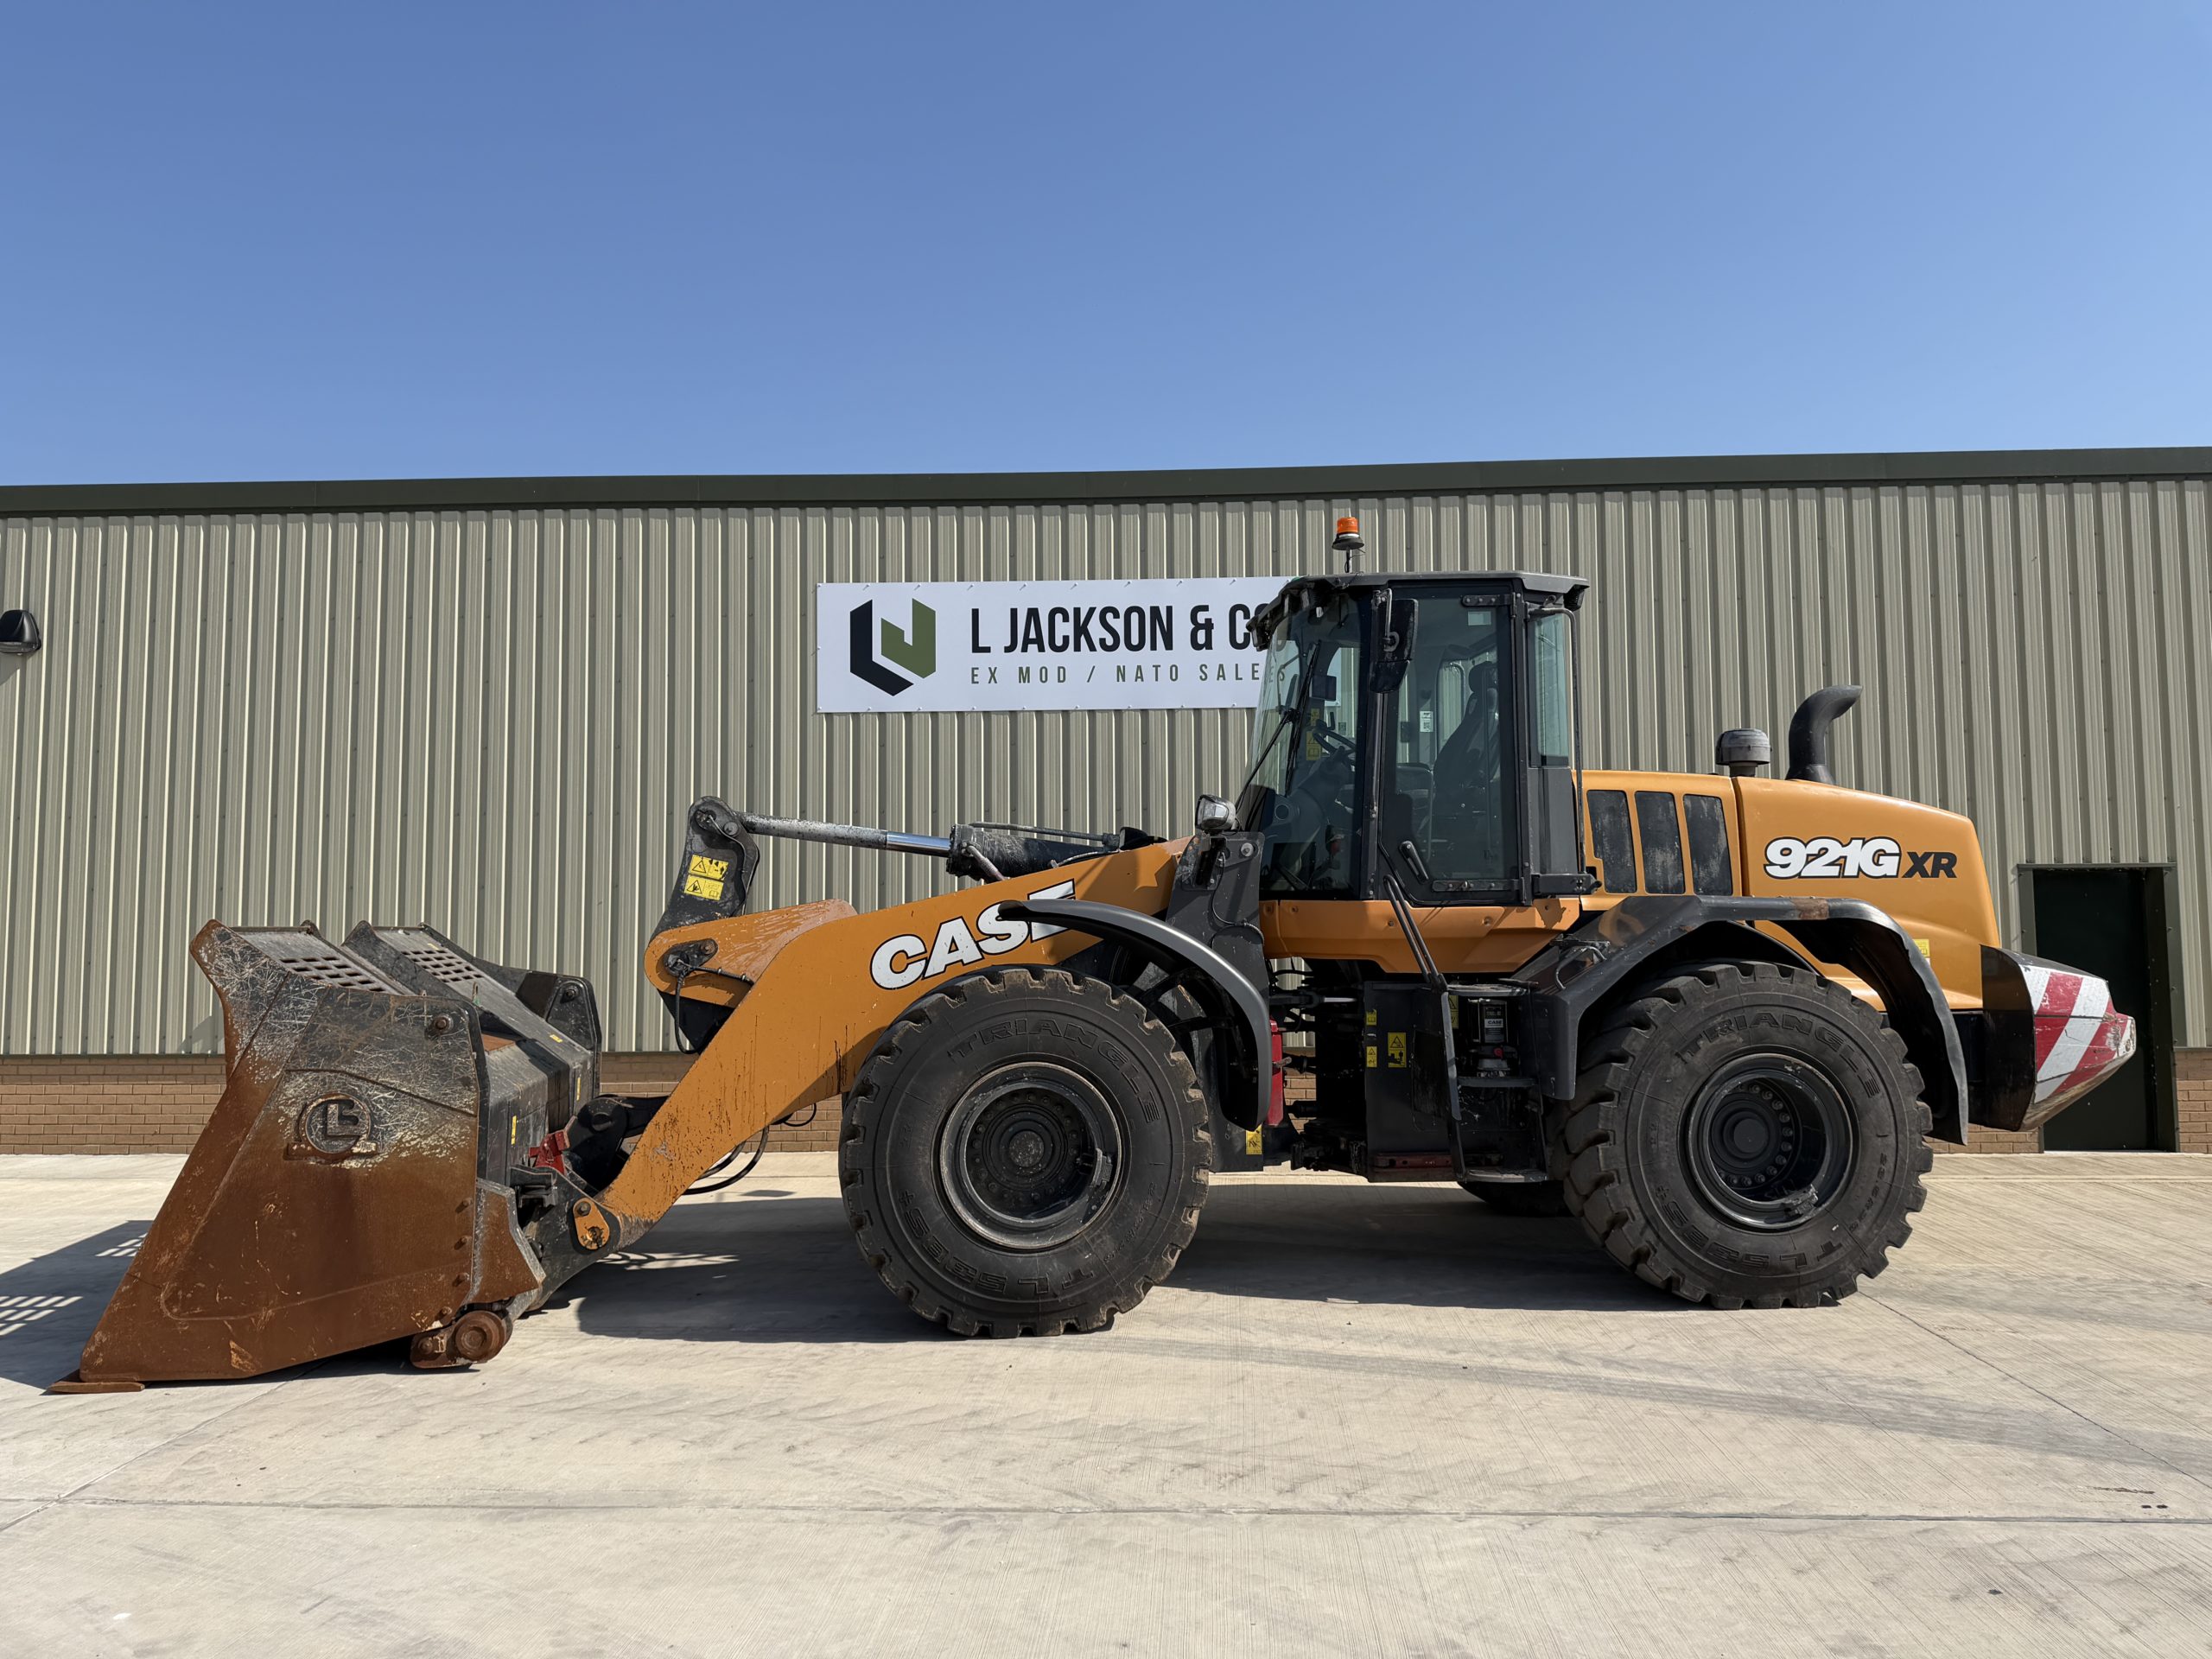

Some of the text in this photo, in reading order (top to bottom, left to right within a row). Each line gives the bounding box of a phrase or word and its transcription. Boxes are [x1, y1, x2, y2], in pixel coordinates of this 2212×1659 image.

[971, 608, 991, 653] L
[1004, 605, 1173, 653] JACKSON
[1190, 604, 1214, 651] &
[971, 667, 998, 684] EX
[1018, 666, 1066, 683] MOD
[1087, 665, 1096, 683] /
[1116, 664, 1179, 683] NATO
[1764, 836, 1957, 880] 921G XR
[946, 1018, 1161, 1123] TRIANGLE
[1674, 1012, 1881, 1098] TRIANGLE
